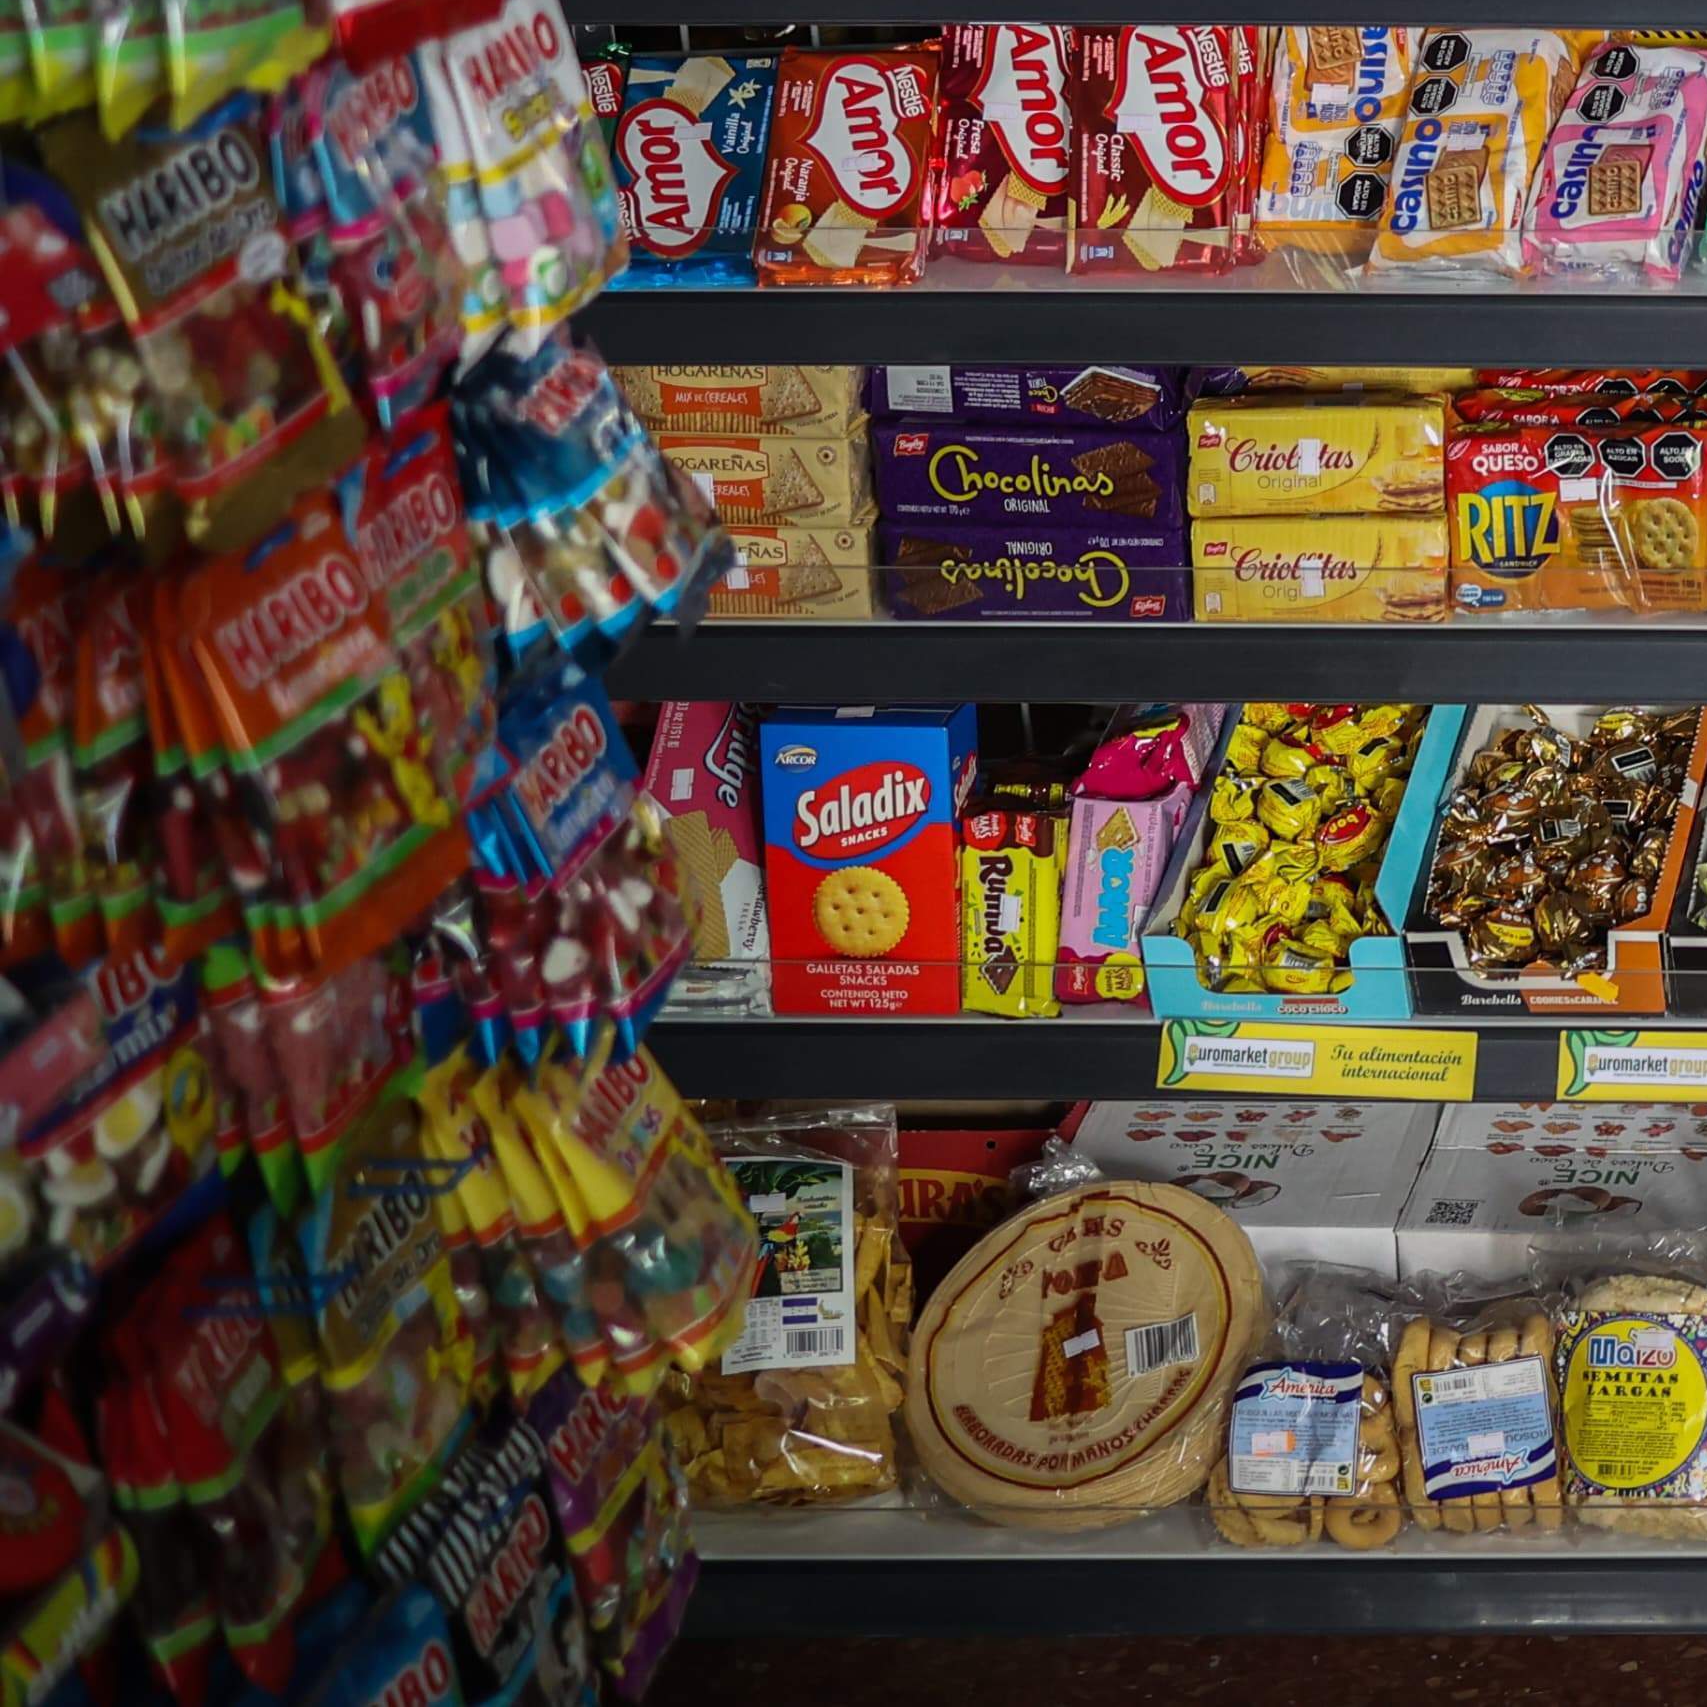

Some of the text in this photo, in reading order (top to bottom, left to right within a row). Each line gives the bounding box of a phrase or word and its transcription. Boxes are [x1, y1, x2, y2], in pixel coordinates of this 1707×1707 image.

[894, 67, 927, 118] Nestlé
[1077, 26, 1238, 187] Amor
[720, 111, 740, 154] Vainilla
[834, 79, 900, 197] Amor
[970, 118, 984, 153] Fresa
[1112, 134, 1127, 181] Classic
[644, 120, 692, 235] Amor
[799, 160, 812, 204] Naranja
[1390, 118, 1443, 237] casino
[1227, 440, 1354, 473] Crioltas
[1481, 444, 1516, 456] SABOR
[929, 445, 1114, 502] Chocolinas
[1472, 455, 1539, 474] QUESO
[1257, 474, 1322, 489] Original
[1004, 499, 1050, 514] ORIGINAL
[1457, 491, 1559, 563] RITZ
[221, 562, 362, 690] HARIBO
[773, 750, 819, 768] ARCOR
[796, 773, 928, 847] Saladix
[840, 827, 889, 847] SNACKS
[806, 963, 919, 975] GALLETAS SALADAS
[820, 989, 908, 999] CONTENIDO NETO
[1330, 1045, 1462, 1068] Tu alimentación
[1340, 1065, 1448, 1082] internacional
[1553, 1167, 1639, 1185] NICE
[1267, 1375, 1337, 1398] América
[1582, 1371, 1679, 1384] SEMITAS
[1587, 1385, 1672, 1399] LARGAS
